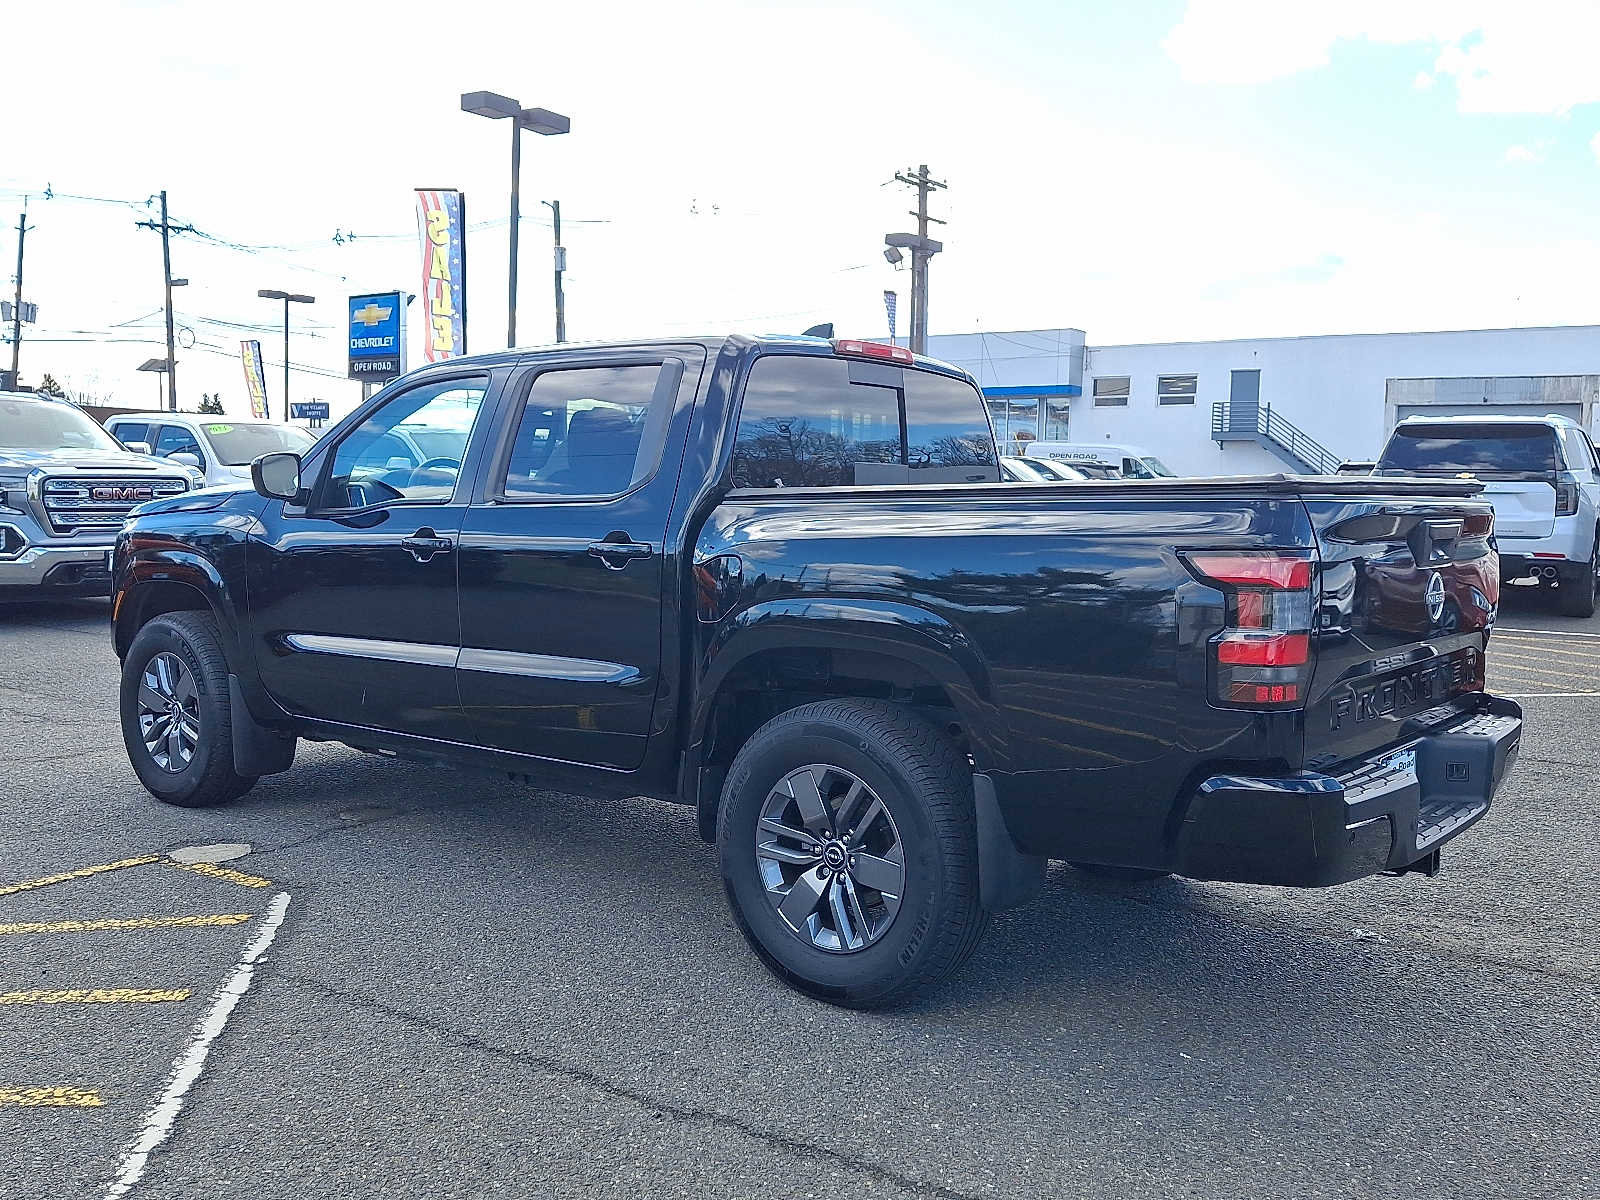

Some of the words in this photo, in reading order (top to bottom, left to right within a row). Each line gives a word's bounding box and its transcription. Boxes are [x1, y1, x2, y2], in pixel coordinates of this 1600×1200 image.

[350, 336, 394, 348] CHEVROLET
[354, 362, 371, 372] OPEN
[373, 361, 392, 371] ROAD
[93, 487, 152, 500] GMC
[1330, 648, 1477, 732] FRONTIER
